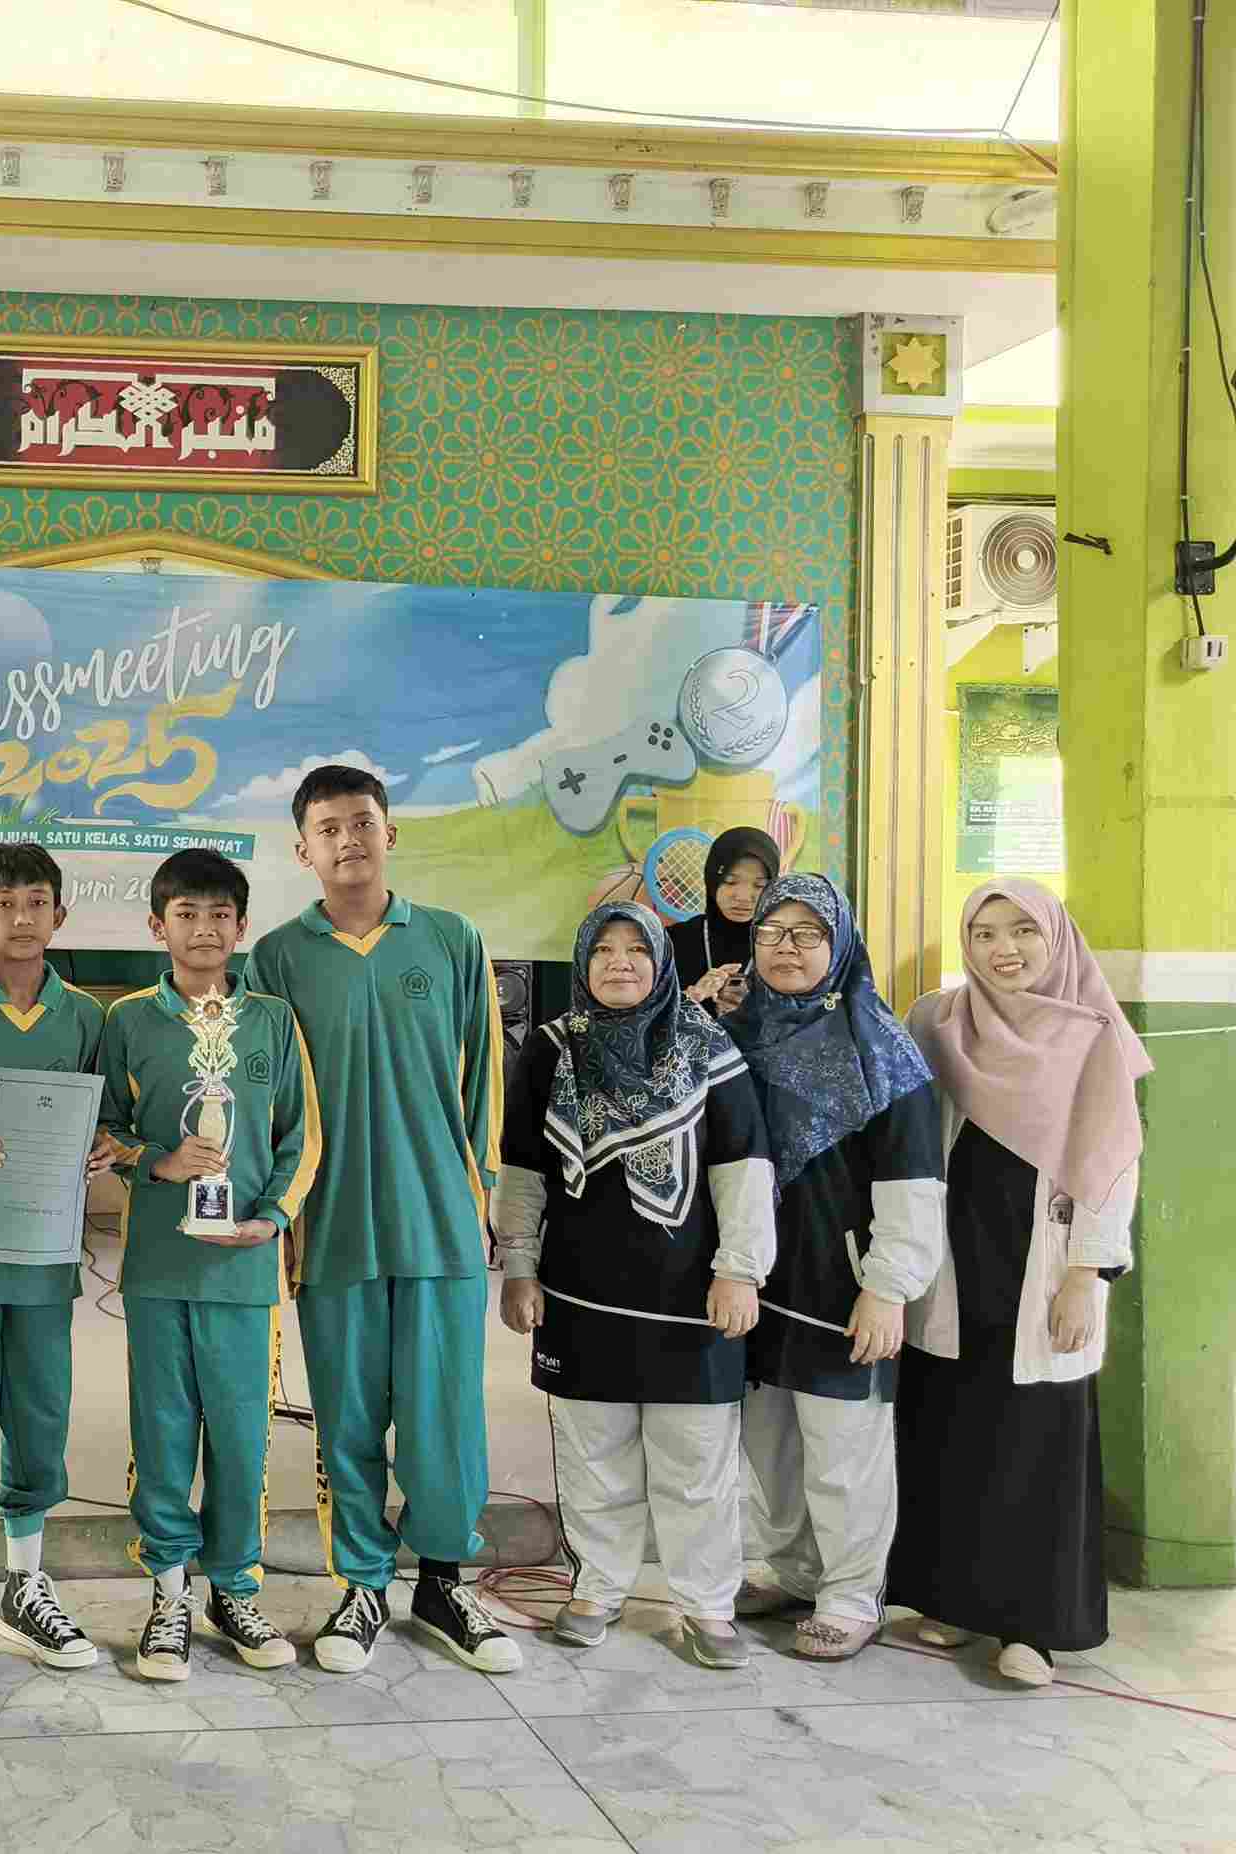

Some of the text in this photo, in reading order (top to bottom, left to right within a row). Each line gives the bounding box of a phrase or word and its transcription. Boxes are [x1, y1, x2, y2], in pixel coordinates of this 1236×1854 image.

[45, 831, 80, 845] SATU
[134, 834, 169, 848] SATU
[172, 836, 244, 853] SEMANGAT
